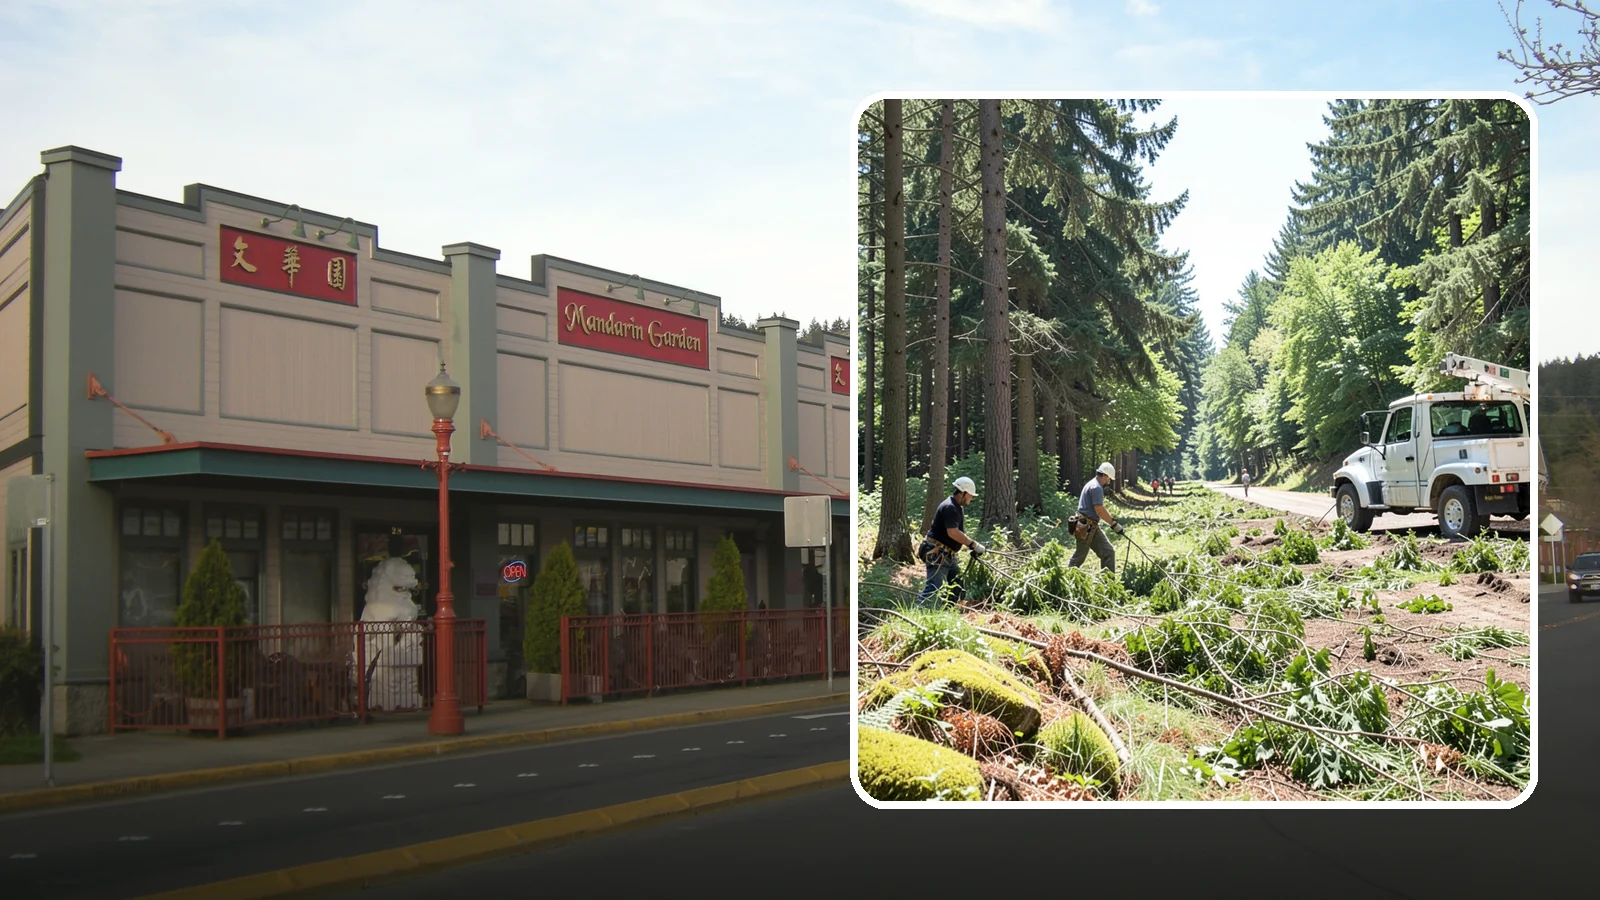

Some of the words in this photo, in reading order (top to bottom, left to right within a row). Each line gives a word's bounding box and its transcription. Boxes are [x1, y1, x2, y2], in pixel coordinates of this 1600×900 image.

[231, 236, 346, 291] 文華園
[564, 302, 644, 341] Mandarin
[648, 320, 702, 352] Garden
[503, 565, 527, 578] OPEN
